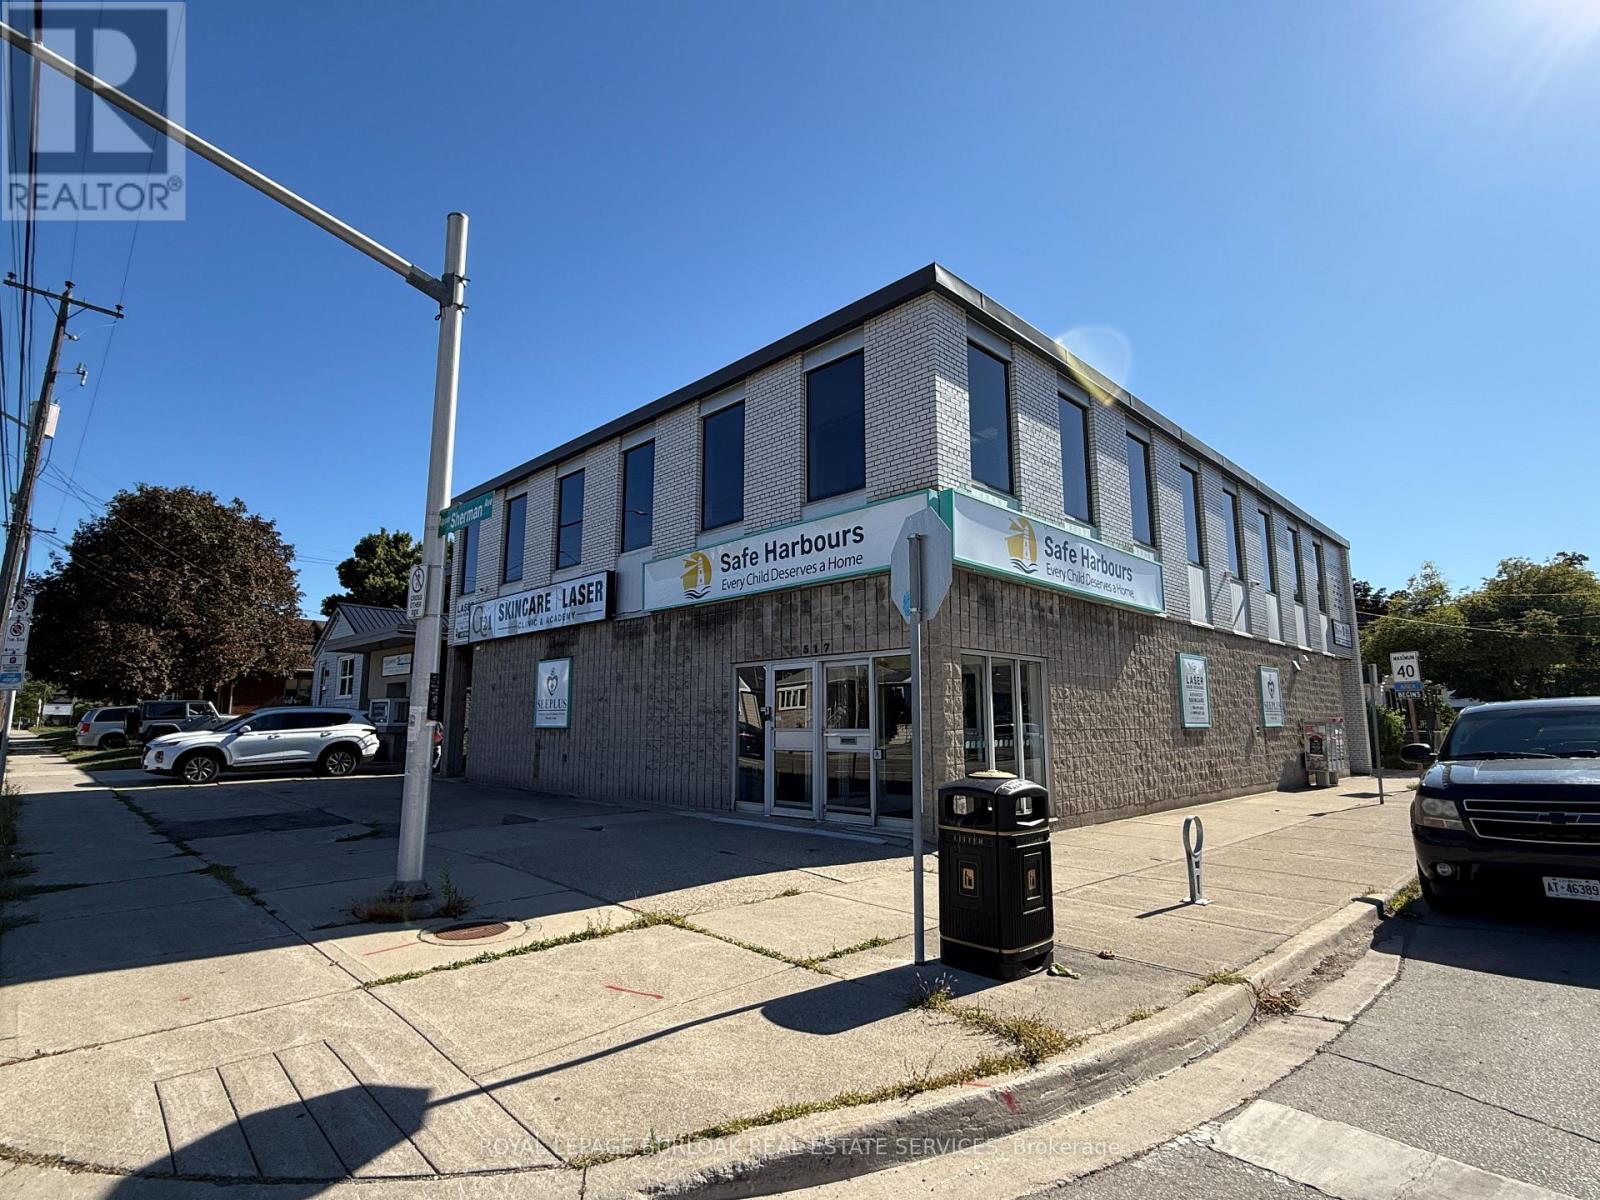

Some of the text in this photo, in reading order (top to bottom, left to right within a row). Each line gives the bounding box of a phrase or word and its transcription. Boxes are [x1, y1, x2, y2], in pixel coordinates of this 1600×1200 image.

[450, 504, 483, 529] Sherman
[720, 525, 865, 573] Safe Harbours
[1044, 536, 1133, 582] Safe Harbours
[721, 554, 864, 591] Every Child Deserves a Home
[1046, 562, 1135, 599] Every Child Deserves a Home
[498, 580, 603, 622] SKINCARE LASER
[518, 619, 537, 630] CLINIC
[545, 611, 576, 625] ACADEMY
[803, 643, 830, 655] 517
[1185, 674, 1204, 686] LASER
[1397, 664, 1415, 678] 40
[1397, 690, 1421, 699] BEGINS
[1547, 881, 1600, 896] AT 46389
